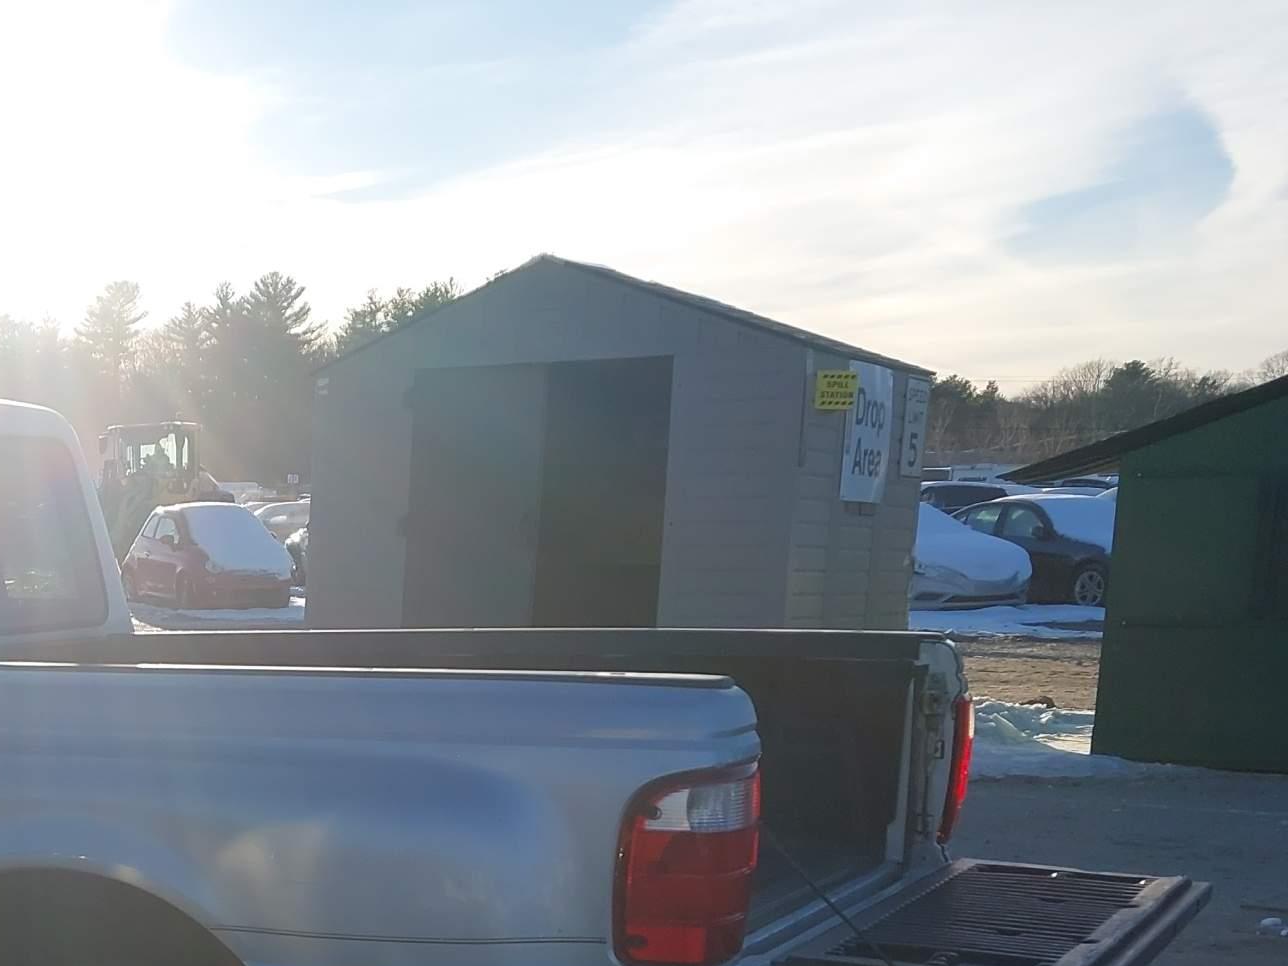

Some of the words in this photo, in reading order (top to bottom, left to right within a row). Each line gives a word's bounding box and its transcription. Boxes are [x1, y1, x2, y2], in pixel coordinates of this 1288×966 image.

[820, 390, 854, 399] STATION
[826, 381, 849, 389] SPILL
[855, 387, 886, 438] Drop
[851, 437, 882, 478] Area
[908, 432, 918, 468] 5
